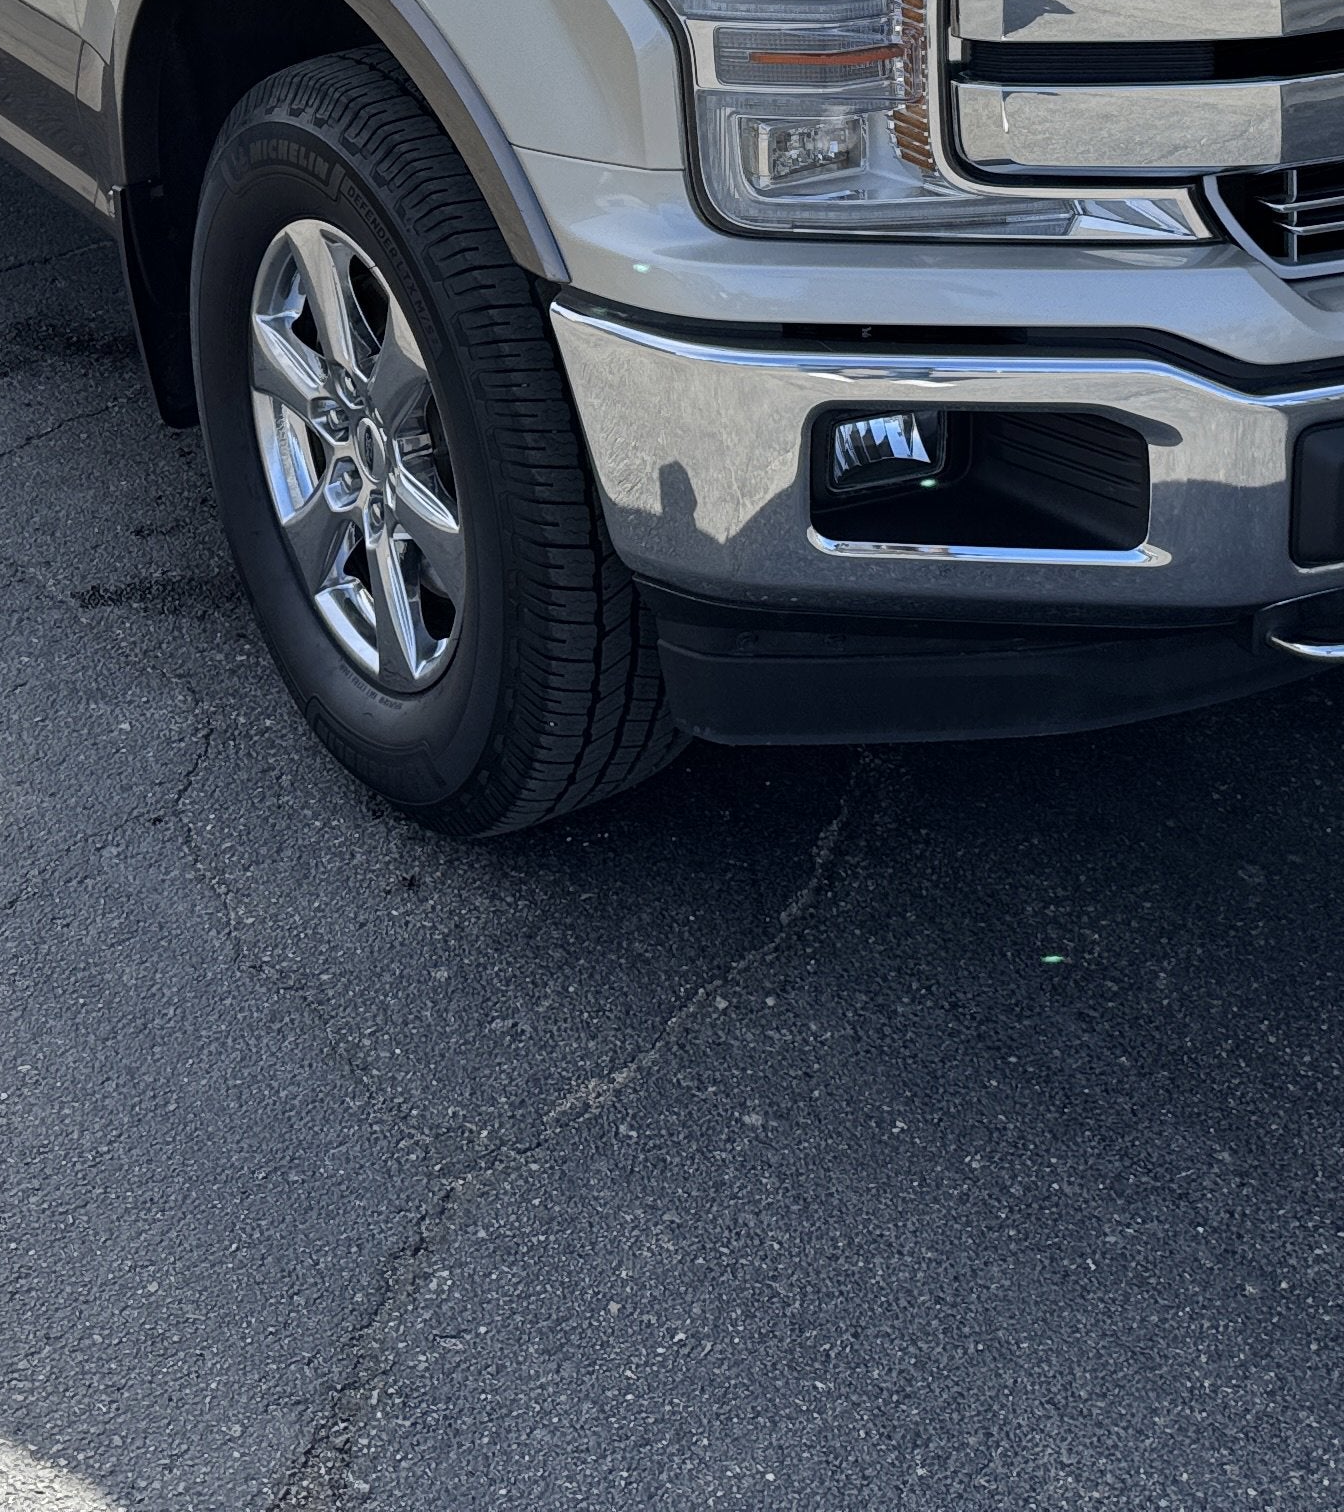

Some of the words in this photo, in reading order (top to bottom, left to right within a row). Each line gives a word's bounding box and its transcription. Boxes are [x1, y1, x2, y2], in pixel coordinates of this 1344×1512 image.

[250, 139, 330, 179] MICHELIN
[346, 187, 398, 261] DEFENDER
[397, 260, 418, 296] LTX
